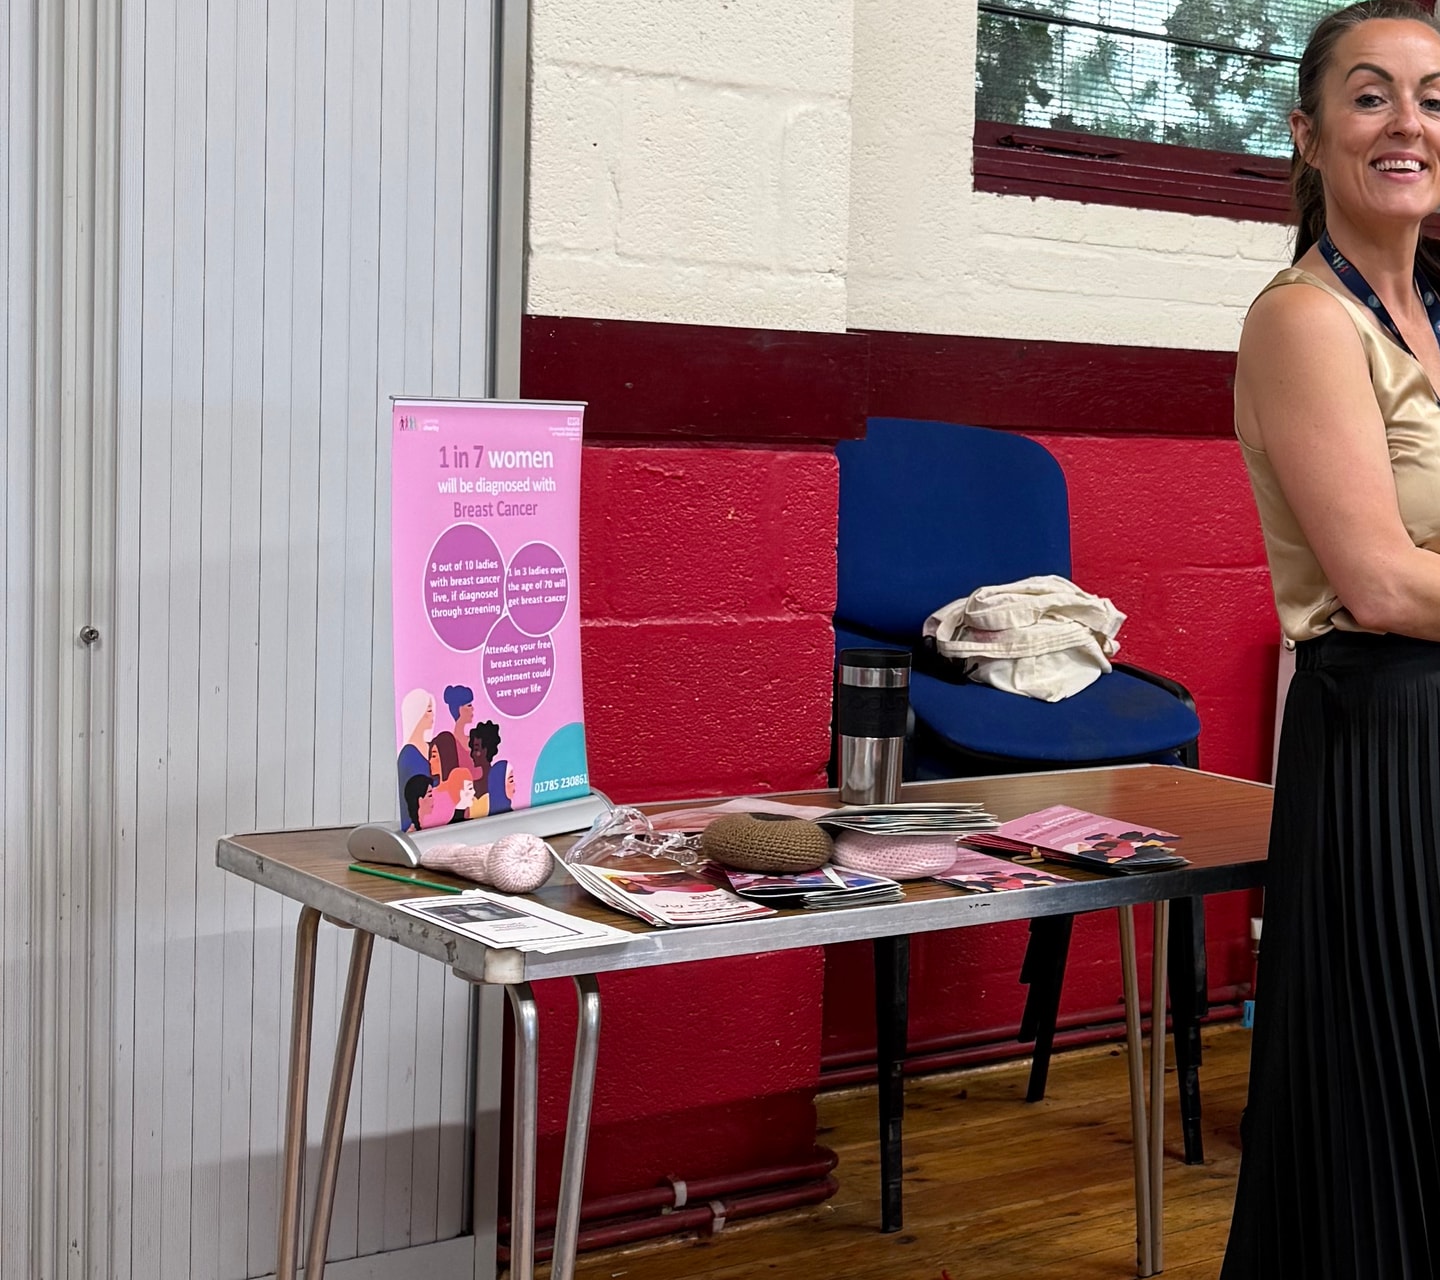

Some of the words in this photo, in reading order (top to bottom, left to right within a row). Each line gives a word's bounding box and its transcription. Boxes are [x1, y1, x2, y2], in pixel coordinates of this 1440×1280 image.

[439, 446, 449, 468] 1
[454, 445, 468, 468] in
[473, 445, 483, 468] 7
[488, 450, 553, 468] women
[438, 478, 456, 493] will
[460, 478, 473, 493] be
[476, 477, 530, 495] diagnosed
[533, 477, 556, 492] with
[454, 502, 493, 518] Breast
[497, 501, 538, 517] Cancer
[432, 563, 436, 572] 9
[439, 562, 452, 572] out
[454, 561, 462, 570] of
[465, 560, 474, 570] 10
[476, 559, 498, 569] ladies
[508, 568, 512, 576] 1
[514, 568, 521, 576] in
[522, 567, 527, 575] 3
[528, 566, 549, 575] ladies
[430, 577, 448, 588] with
[450, 576, 473, 586] breast
[508, 582, 519, 591] the
[521, 582, 533, 592] age
[535, 581, 542, 590] of
[544, 580, 552, 588] 70
[554, 579, 566, 588] will
[451, 591, 457, 601] if
[459, 588, 498, 602] diagnosed
[508, 597, 519, 607] get
[521, 596, 542, 605] breast
[432, 606, 462, 618] through
[464, 603, 500, 615] screening
[485, 644, 518, 654] Attending
[520, 642, 535, 652] your
[538, 640, 551, 649] free
[491, 660, 512, 669] breast
[514, 656, 546, 665] screening
[487, 671, 530, 684] appointment
[532, 668, 551, 678] could
[497, 688, 512, 697] save
[513, 687, 529, 697] your
[530, 684, 541, 692] life
[535, 779, 559, 793] 01785
